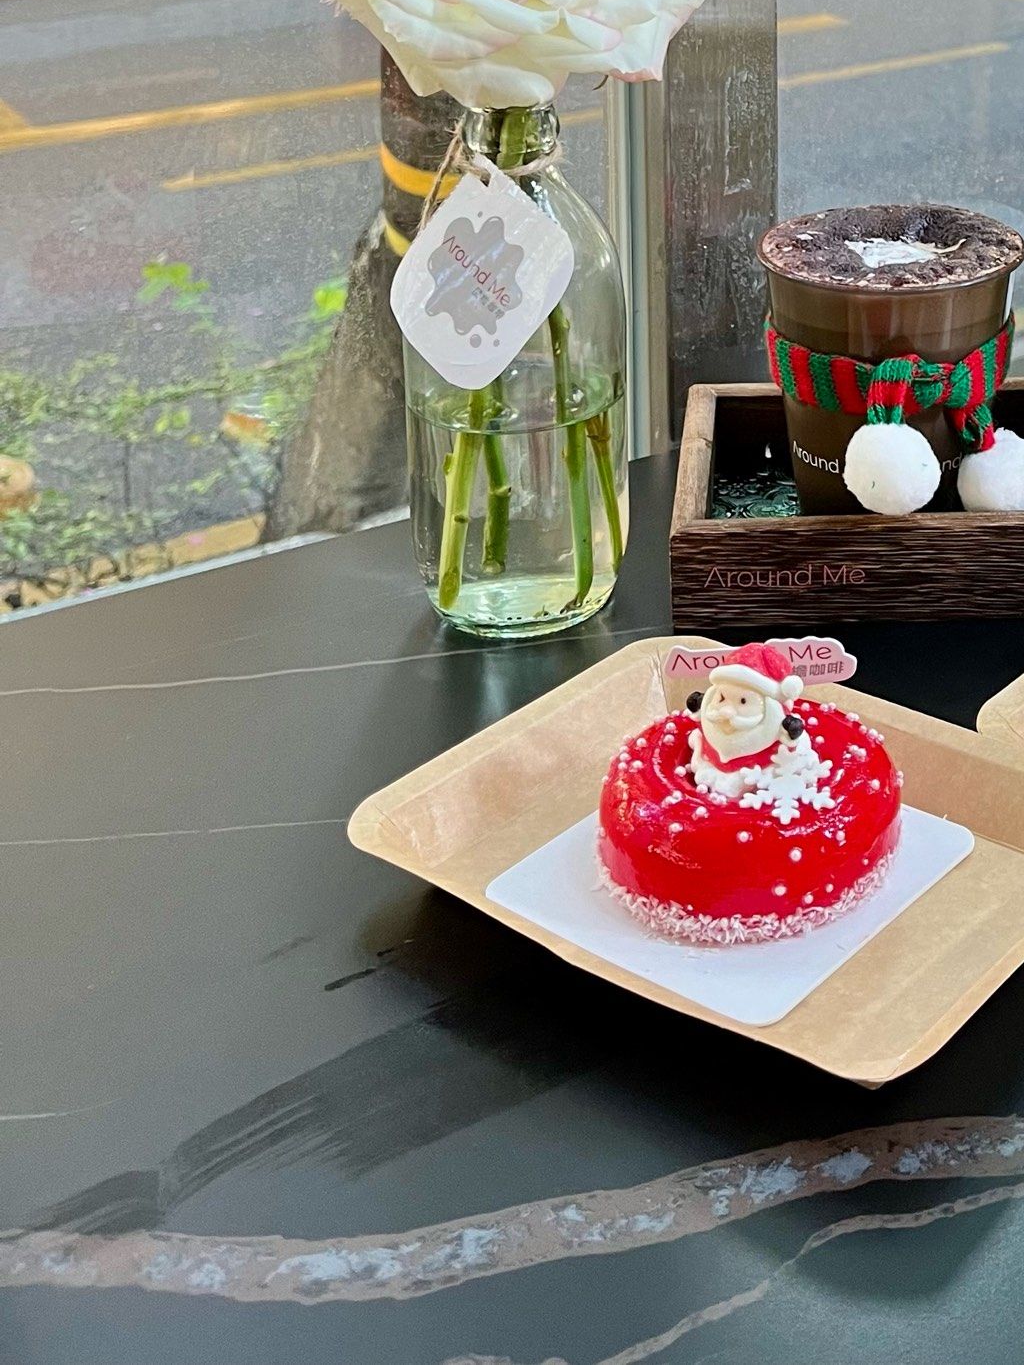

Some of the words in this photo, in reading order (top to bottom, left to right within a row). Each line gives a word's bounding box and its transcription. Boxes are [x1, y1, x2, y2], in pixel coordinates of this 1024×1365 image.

[442, 235, 492, 285] Around
[487, 279, 511, 307] Me
[792, 440, 840, 474] Around
[704, 564, 813, 588] Around
[823, 564, 866, 585] Me
[671, 653, 725, 671] Aro
[788, 644, 832, 663] Me
